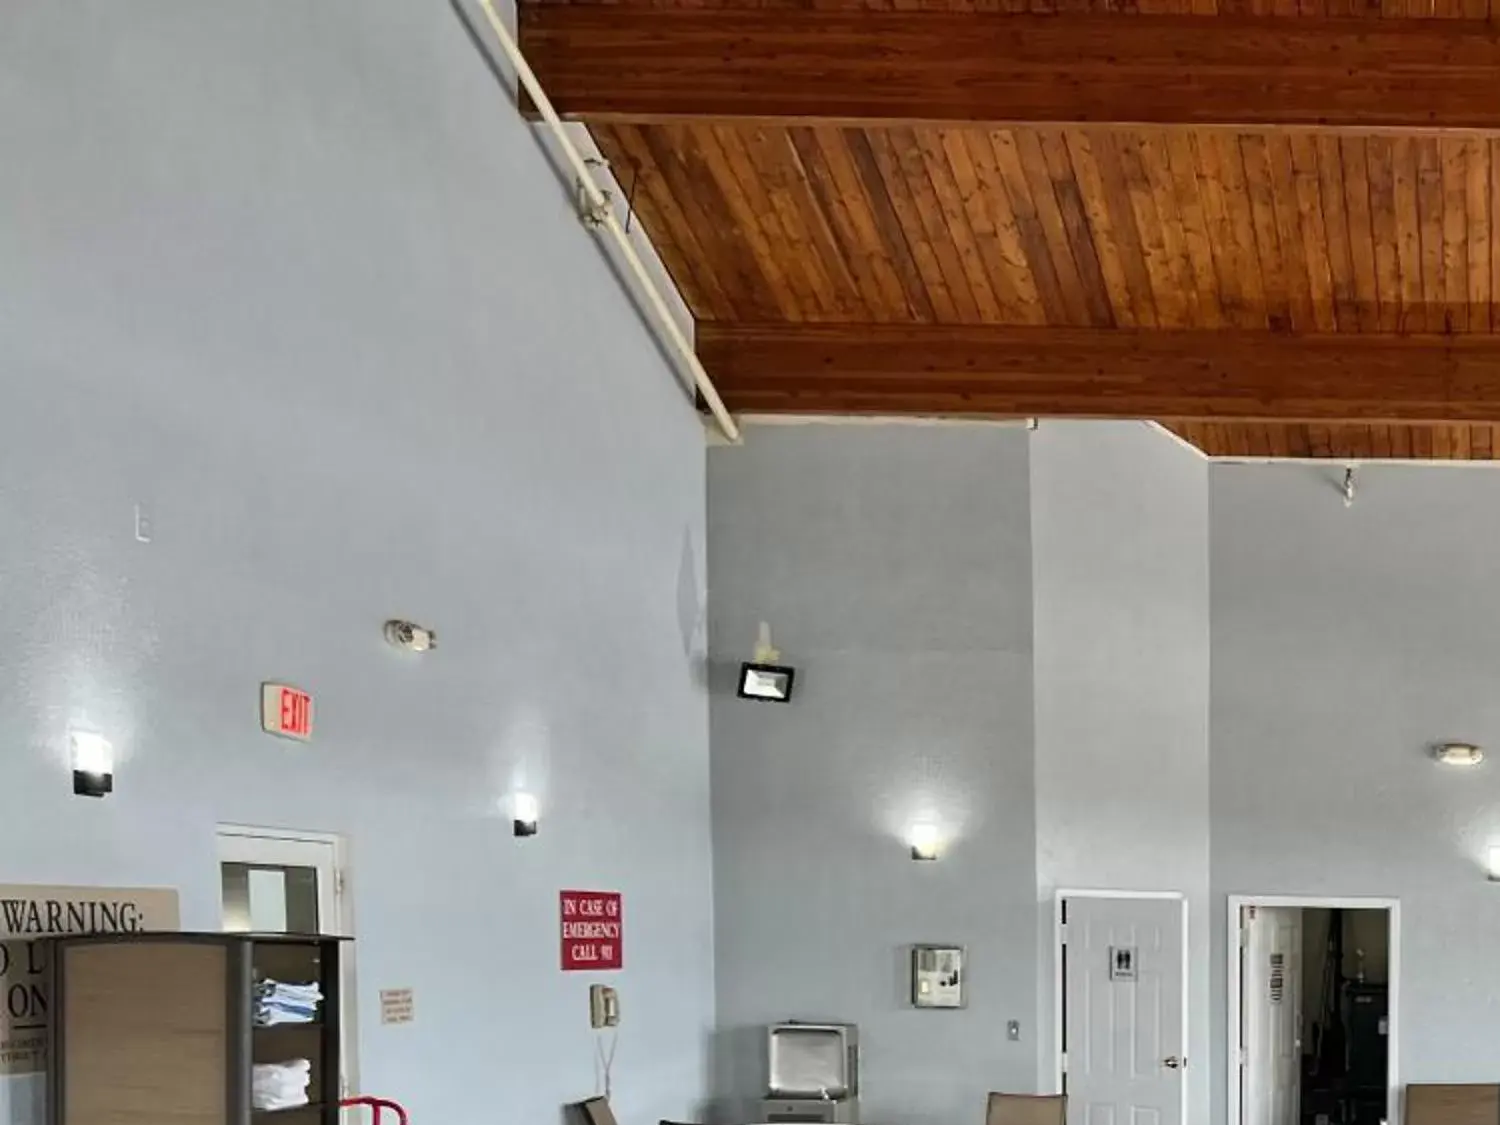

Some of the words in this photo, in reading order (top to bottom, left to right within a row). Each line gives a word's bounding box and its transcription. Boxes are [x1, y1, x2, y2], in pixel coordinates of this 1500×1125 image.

[280, 688, 312, 736] EXIT
[1, 899, 144, 935] WARNING:
[563, 898, 577, 916] IN
[579, 899, 604, 916] CASE
[606, 900, 618, 917] OF
[563, 921, 619, 939] EMERGENCY
[572, 944, 599, 961] CALL
